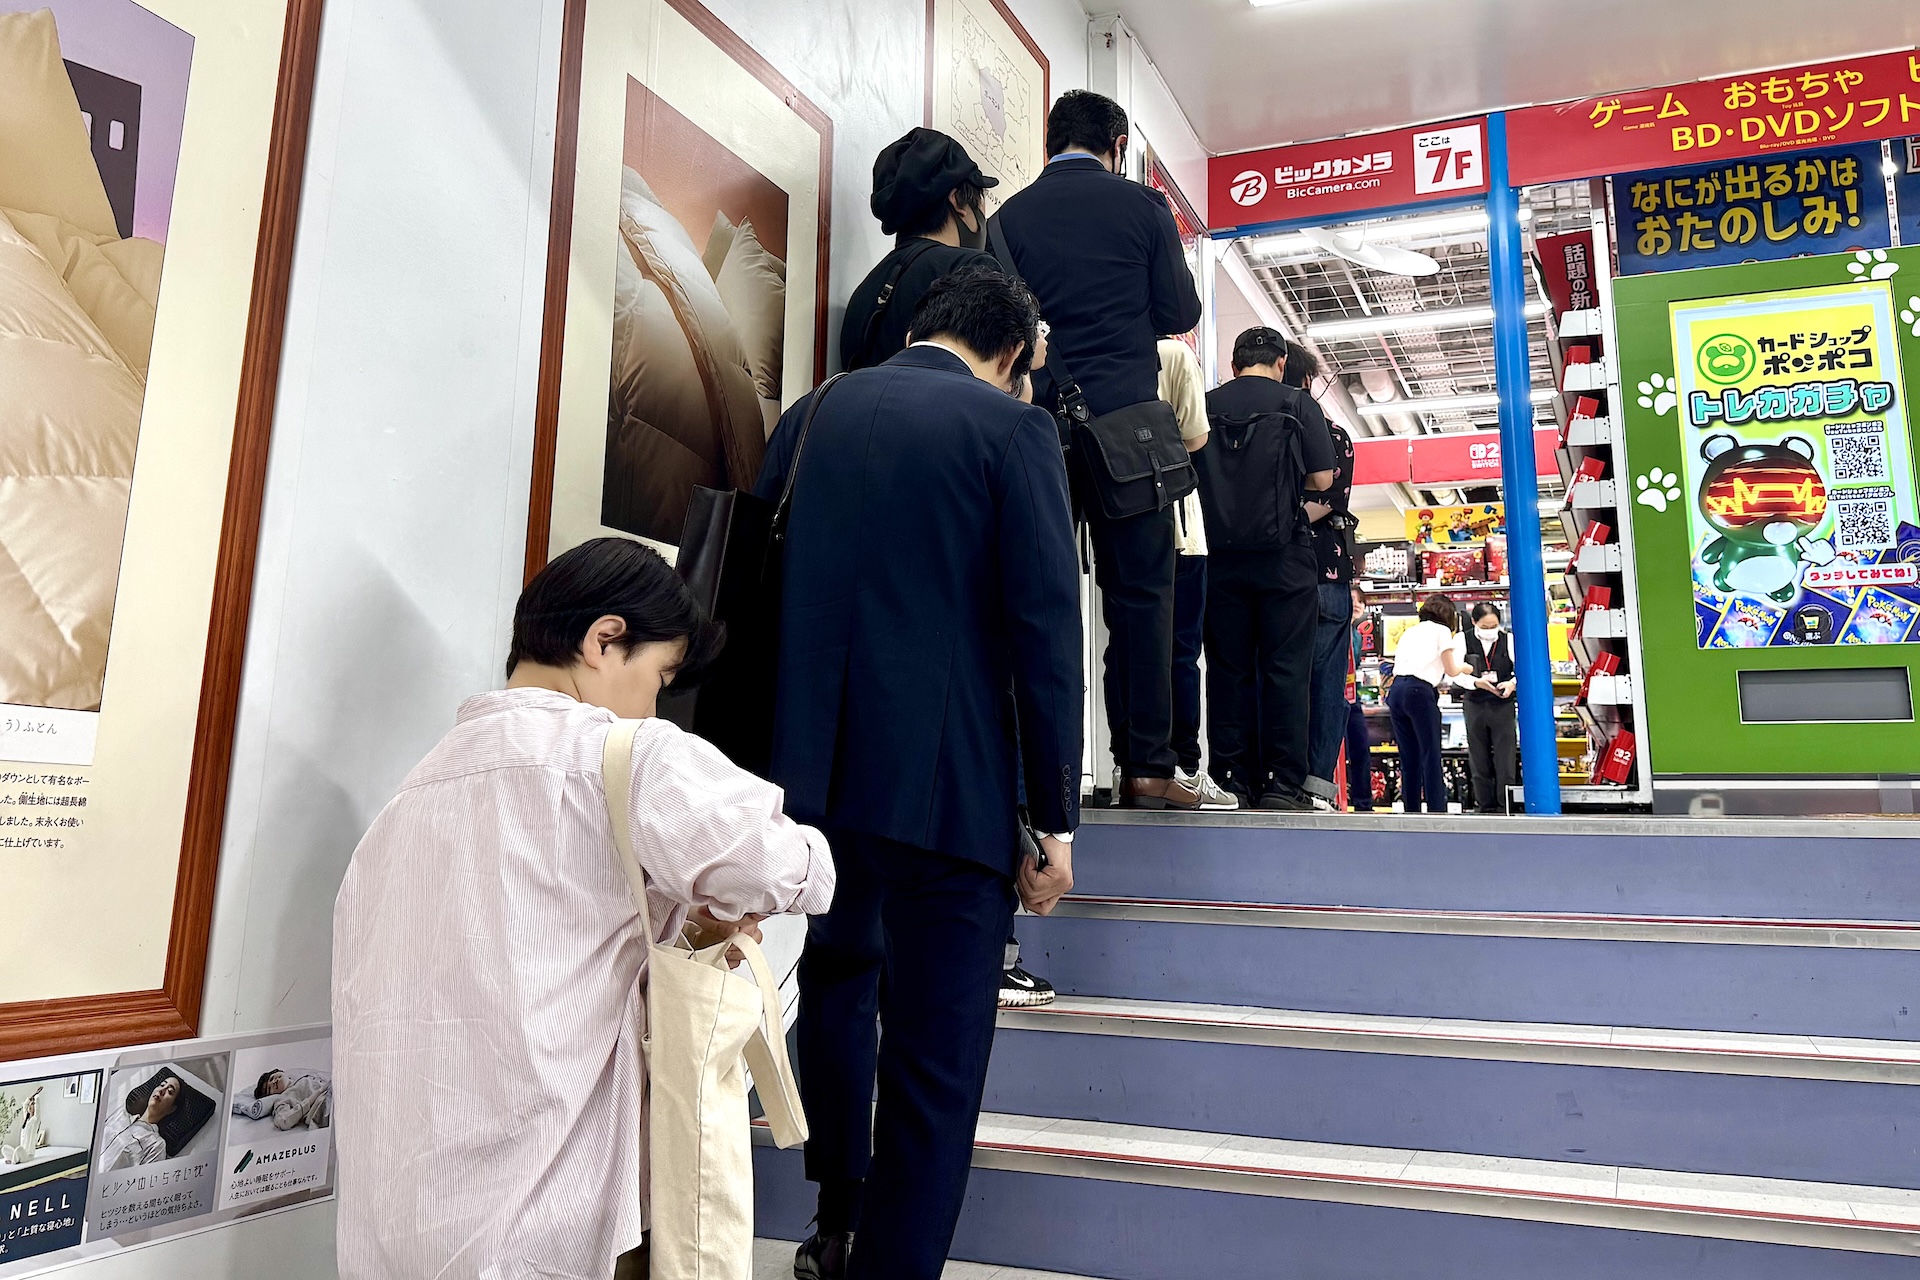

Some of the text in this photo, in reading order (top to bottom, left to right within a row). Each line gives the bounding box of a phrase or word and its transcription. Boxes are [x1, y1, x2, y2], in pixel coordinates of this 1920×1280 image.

[1723, 70, 1864, 111] おもちゃ
[1589, 92, 1690, 129] ゲーム
[1418, 136, 1451, 148] ここは
[1274, 150, 1393, 184] ビックカメラ
[1425, 147, 1473, 184] 7F
[1286, 178, 1380, 199] BicCamera.com
[1630, 157, 1858, 212] なにが出るかは
[1757, 325, 1872, 352] カードショップ
[1690, 380, 1892, 426] トレカガチャ
[256, 1144, 316, 1165] AMAZEPLUS
[230, 1167, 296, 1189] 心地よい睡眠をサポート
[10, 1193, 70, 1220] NELL
[101, 1190, 194, 1219] ヒツジを数える間もなく眠って
[0, 1217, 75, 1242] 」と「上質な寝心地」
